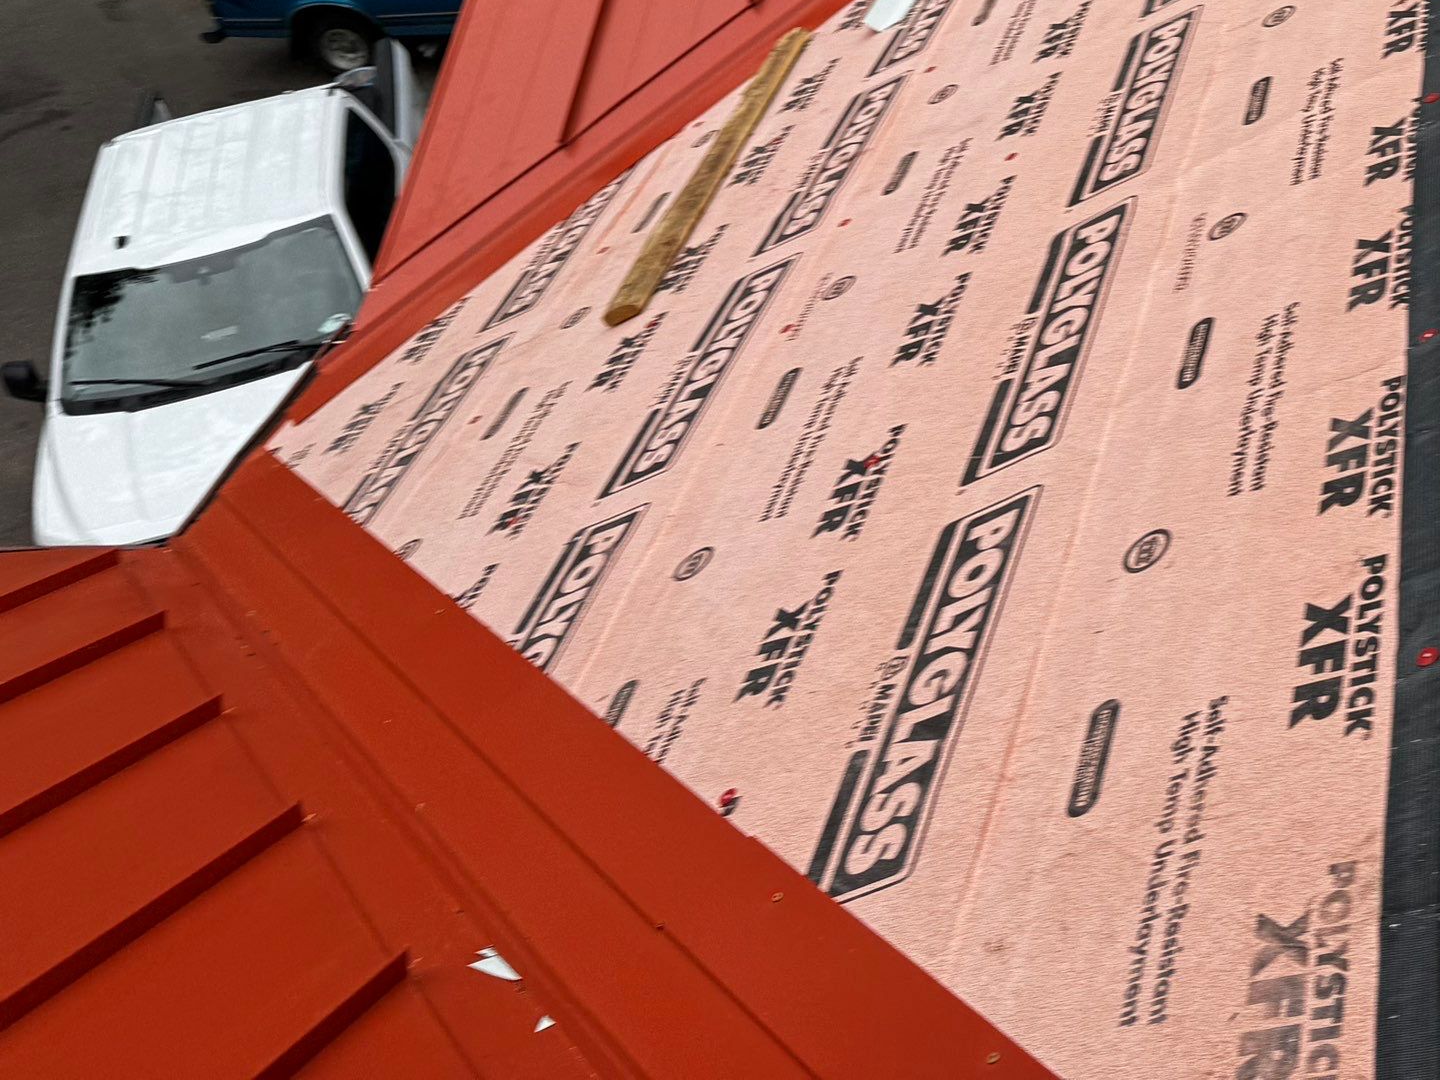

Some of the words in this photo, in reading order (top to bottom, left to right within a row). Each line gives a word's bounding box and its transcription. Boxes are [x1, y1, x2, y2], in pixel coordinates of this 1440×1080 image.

[1101, 18, 1187, 180] POLYGLASS
[1382, 1, 1418, 59] XFR
[785, 83, 895, 234] POLYGLASS
[1364, 115, 1405, 187] XFR
[889, 294, 946, 367] XFR
[1003, 216, 1118, 451] POLYGLASS
[1347, 228, 1393, 312] XFR
[635, 269, 781, 471] POLYGLASS
[811, 450, 877, 538] XFR
[1318, 406, 1373, 516] XFR
[1367, 373, 1407, 516] POLYSTICK
[734, 599, 810, 703] XFR
[763, 568, 842, 710] POLYSTICK
[847, 512, 1015, 872] POLYGLASS
[1288, 591, 1352, 728] XFR
[1344, 552, 1387, 737] POLYSTICK
[647, 677, 707, 770] Self-Adher
[1182, 694, 1229, 846] Self-Adhered
[1116, 838, 1176, 1029] Underlayment
[1146, 848, 1201, 1027] Fire-Resistant
[1307, 861, 1358, 1080] POLYSTIC
